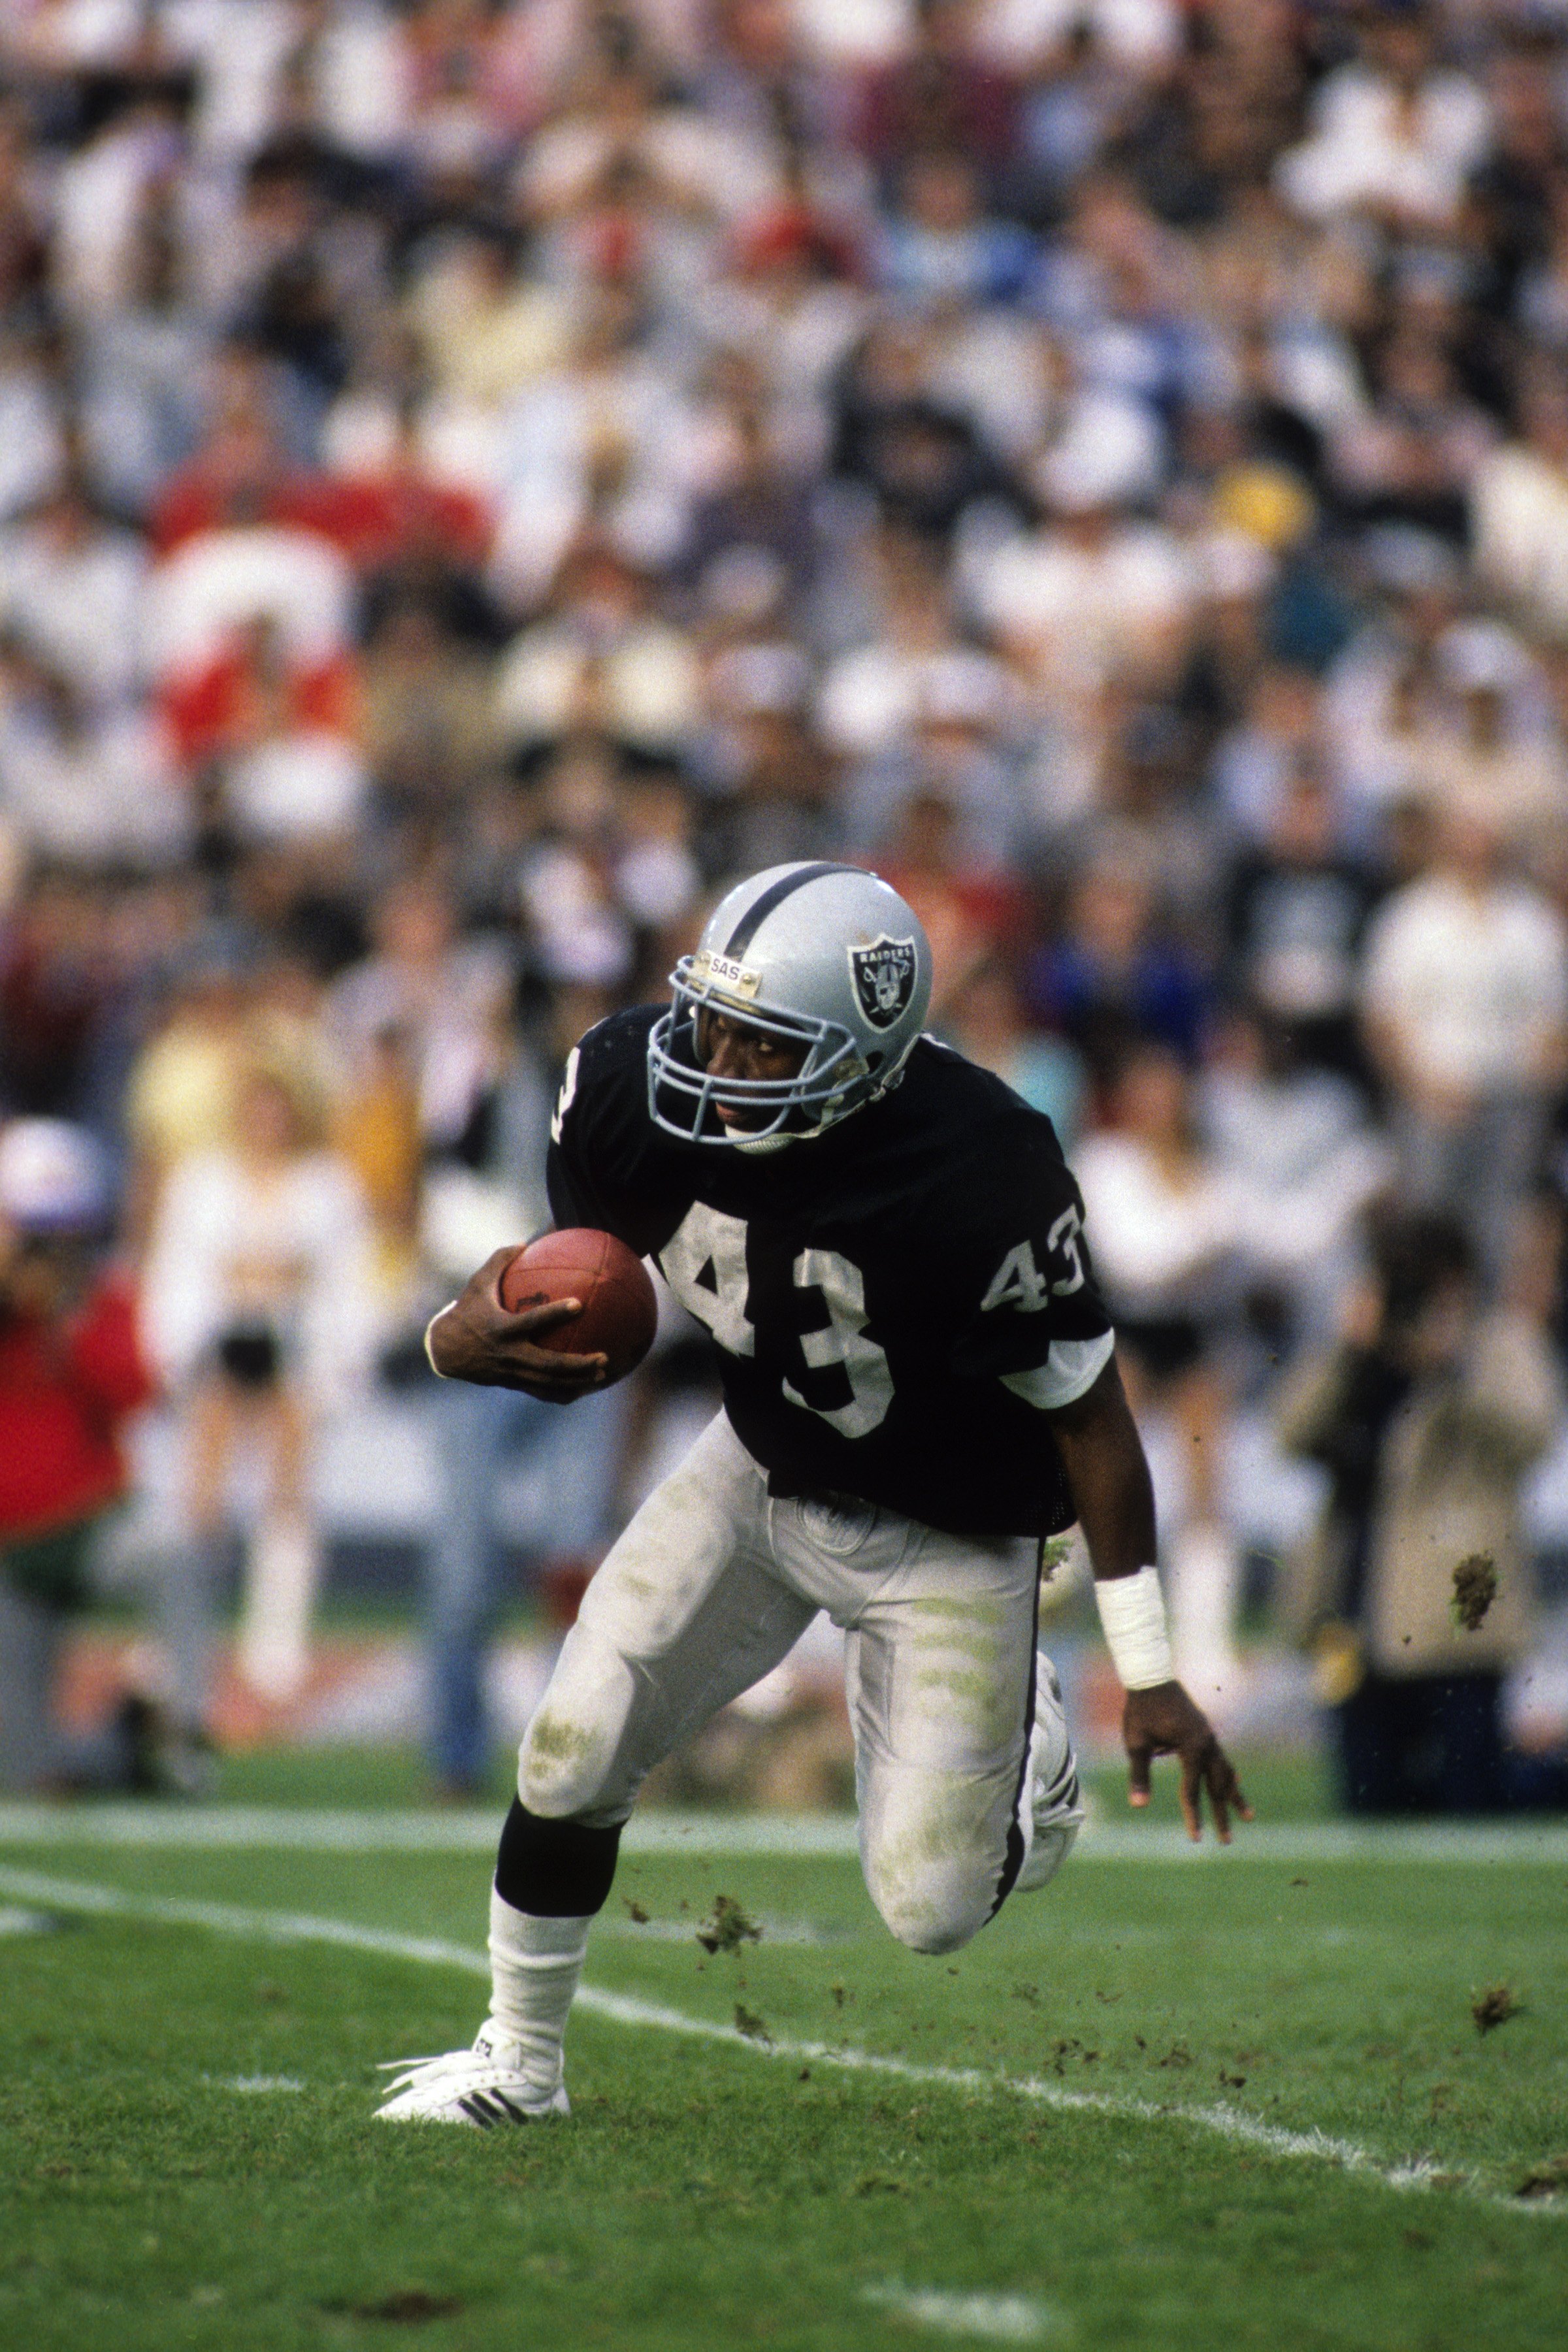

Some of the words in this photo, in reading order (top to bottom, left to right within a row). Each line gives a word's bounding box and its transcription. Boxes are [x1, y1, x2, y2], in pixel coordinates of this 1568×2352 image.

[711, 958, 740, 981] SAS
[860, 947, 910, 963] RAIDERS
[980, 1203, 1085, 1313] 43
[659, 1200, 895, 1438] 43
